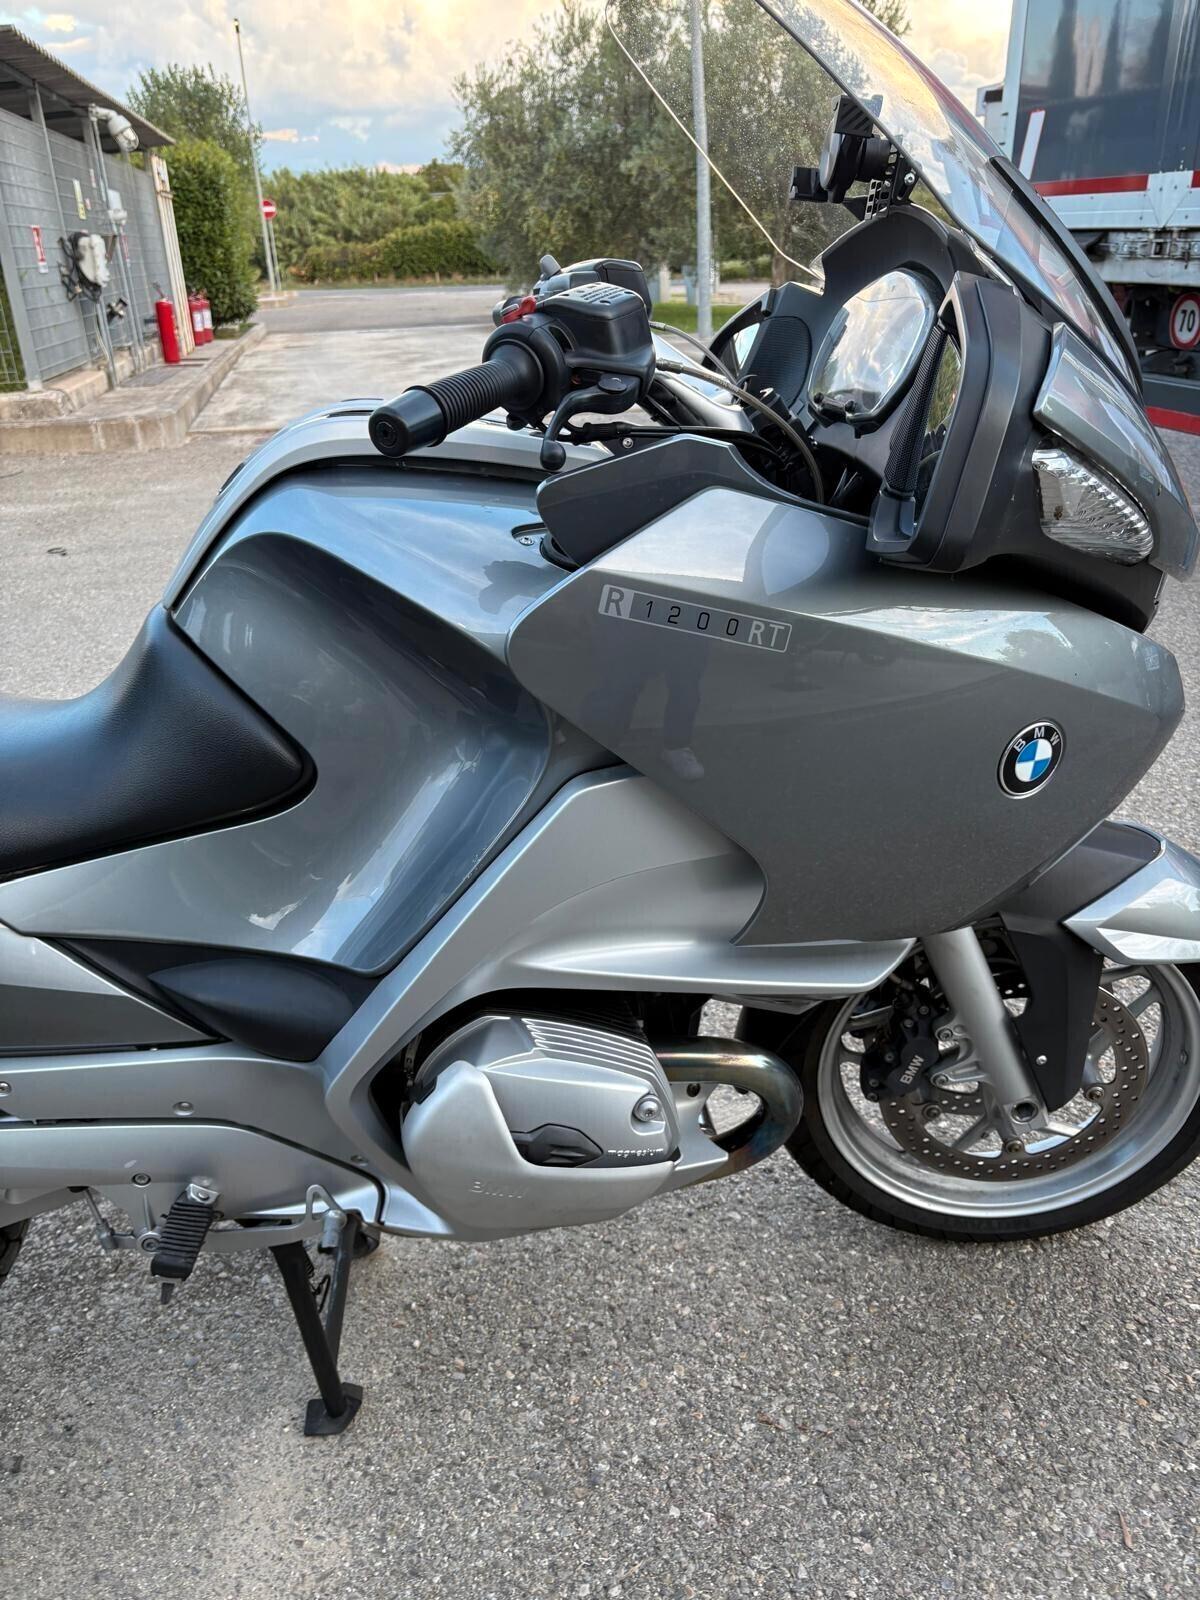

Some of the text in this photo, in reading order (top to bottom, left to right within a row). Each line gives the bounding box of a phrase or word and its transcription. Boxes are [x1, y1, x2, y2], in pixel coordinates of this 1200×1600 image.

[1179, 308, 1196, 333] 70
[604, 586, 785, 648] R 1200 RT
[1013, 726, 1060, 752] BMW
[900, 1054, 925, 1085] BMW
